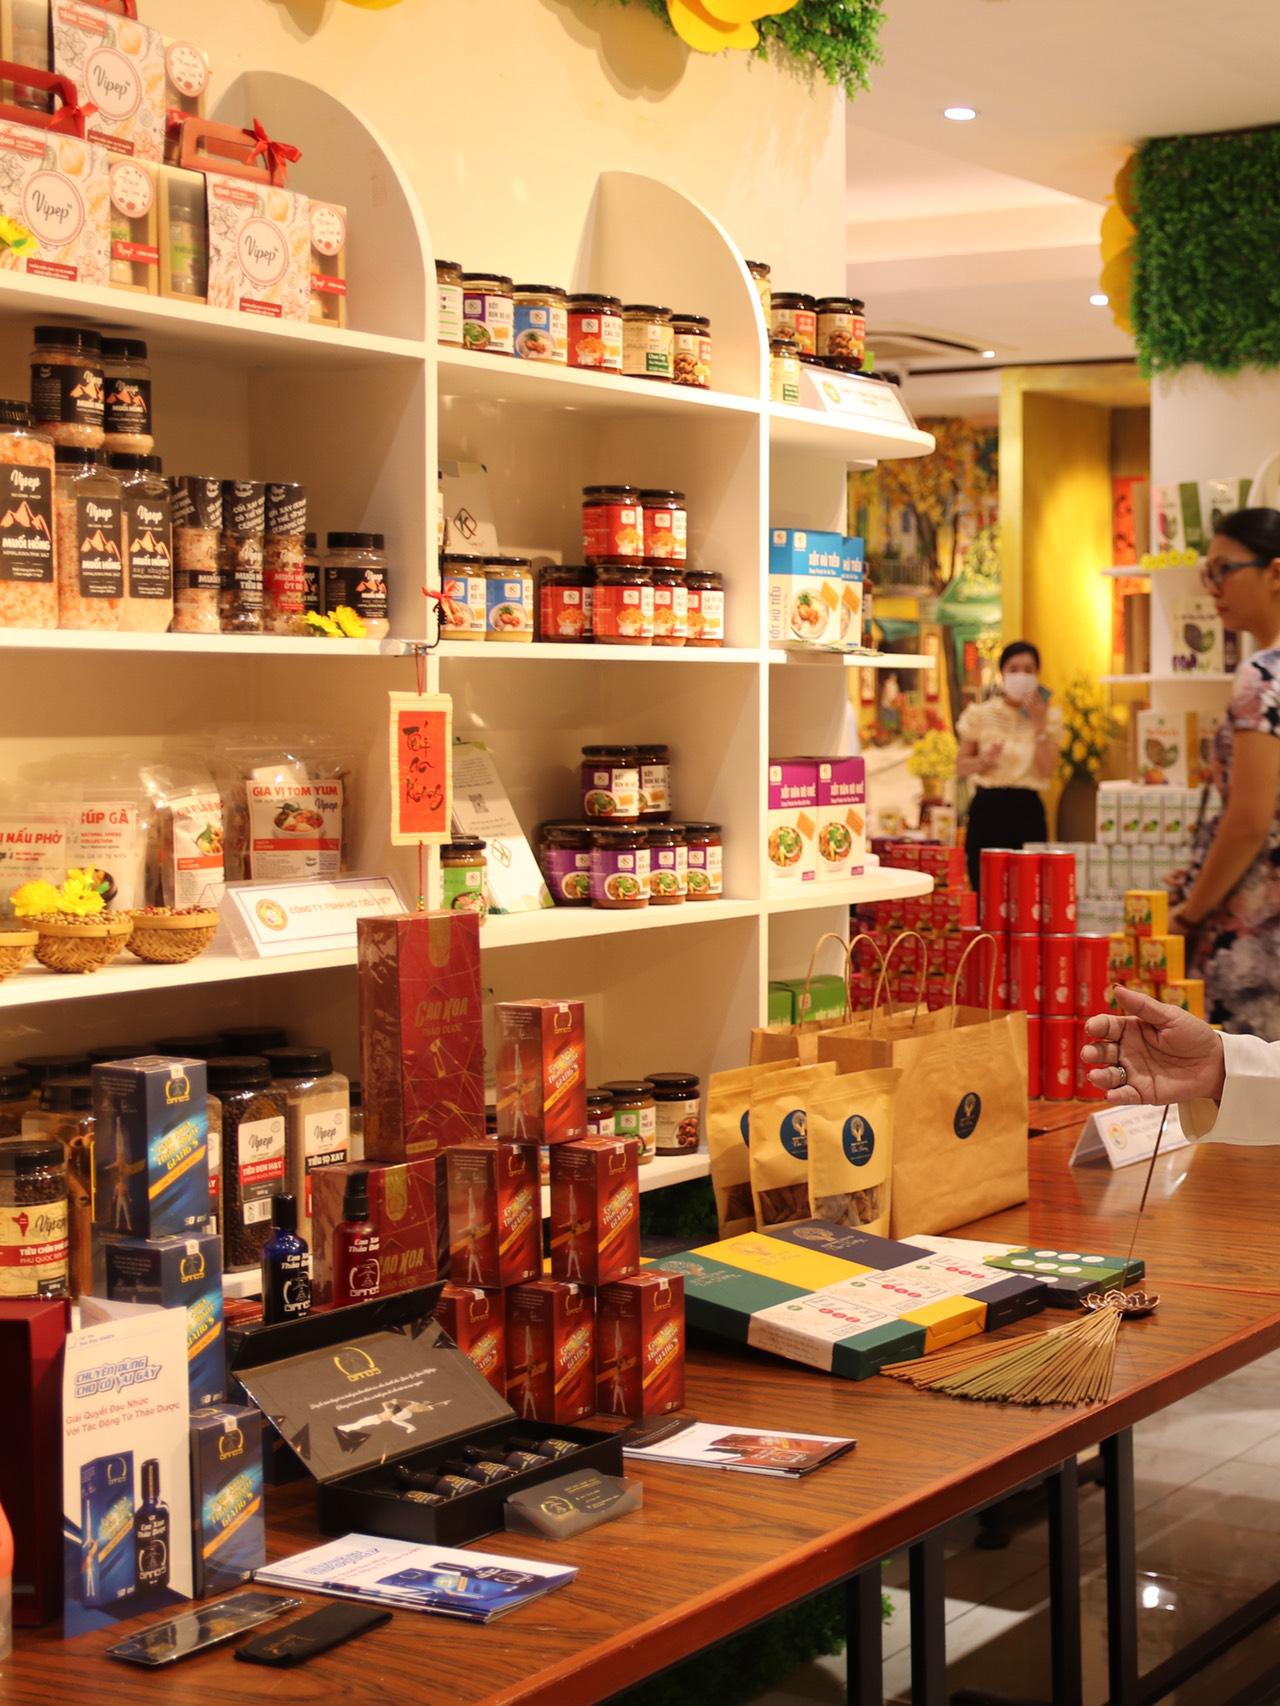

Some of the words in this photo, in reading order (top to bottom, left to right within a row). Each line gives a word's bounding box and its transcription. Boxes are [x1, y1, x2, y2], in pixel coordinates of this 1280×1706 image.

[93, 65, 129, 100] Vipep
[32, 190, 69, 224] Vipep
[245, 235, 277, 266] Vipep
[86, 502, 113, 522] Vipep
[137, 505, 163, 525] Vipep
[2, 534, 27, 548] MUỐI
[28, 536, 51, 550] HỒNG
[253, 787, 271, 797] GIA
[275, 787, 285, 797] VỊ
[287, 786, 311, 796] TOM
[314, 785, 338, 796] YUM
[109, 809, 129, 824] GÀ
[6, 827, 32, 843] NẤU
[35, 829, 63, 844] PHỞ
[314, 1125, 337, 1142] Vipep
[248, 1134, 273, 1152] Vipep
[330, 1152, 344, 1163] XAY
[349, 1245, 368, 1253] Thảo
[354, 1238, 369, 1246] Cao
[19, 1246, 37, 1256] TIÊU
[287, 1254, 299, 1262] Cao
[281, 1261, 300, 1270] Thảo
[399, 1247, 425, 1275] XOA
[77, 1364, 114, 1383] CHUYÊN
[77, 1383, 96, 1396] CHO
[116, 1374, 133, 1393] VAI
[84, 1406, 108, 1420] Quyết
[110, 1404, 125, 1413] Đau
